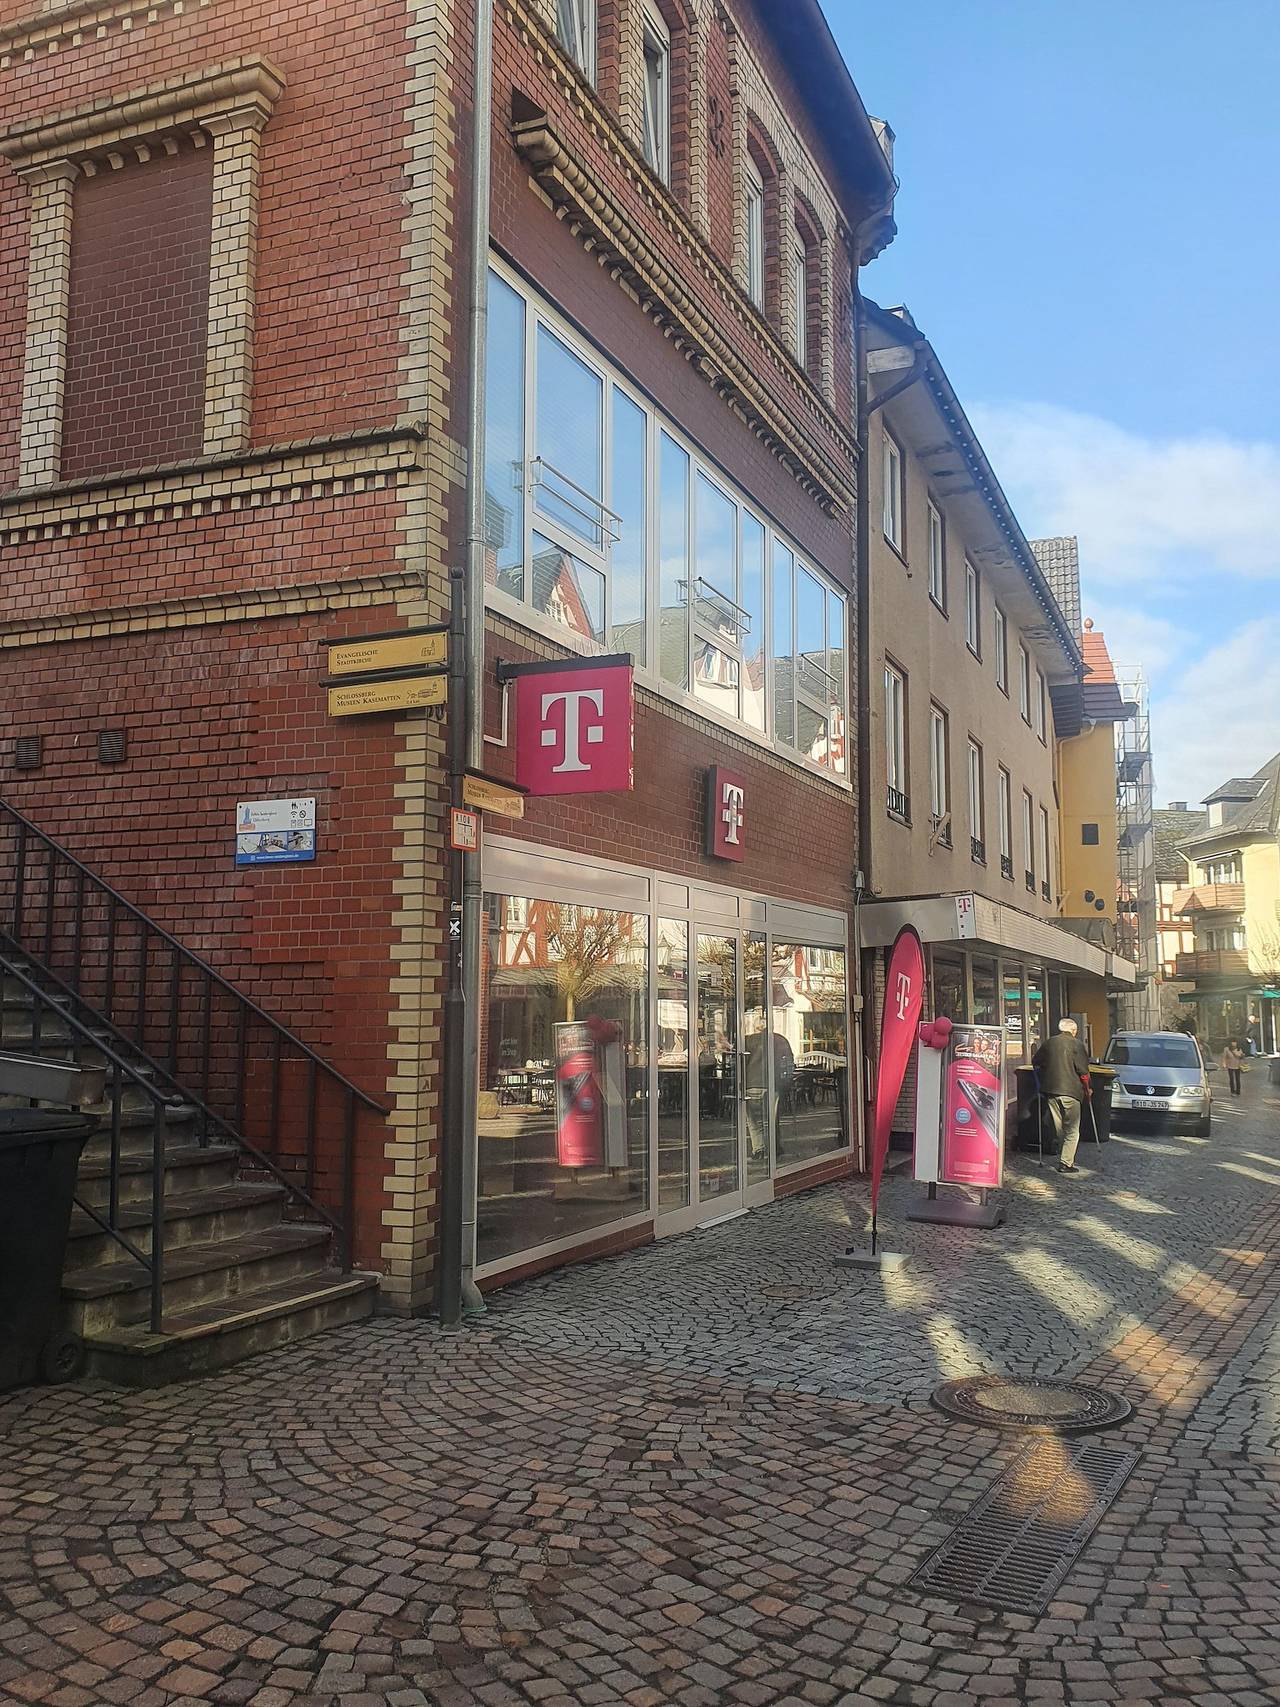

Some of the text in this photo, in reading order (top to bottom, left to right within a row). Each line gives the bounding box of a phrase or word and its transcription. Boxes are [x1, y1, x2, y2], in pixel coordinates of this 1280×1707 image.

[541, 689, 604, 773] T
[722, 782, 744, 845] T
[958, 897, 971, 913] T
[896, 972, 912, 1021] T
